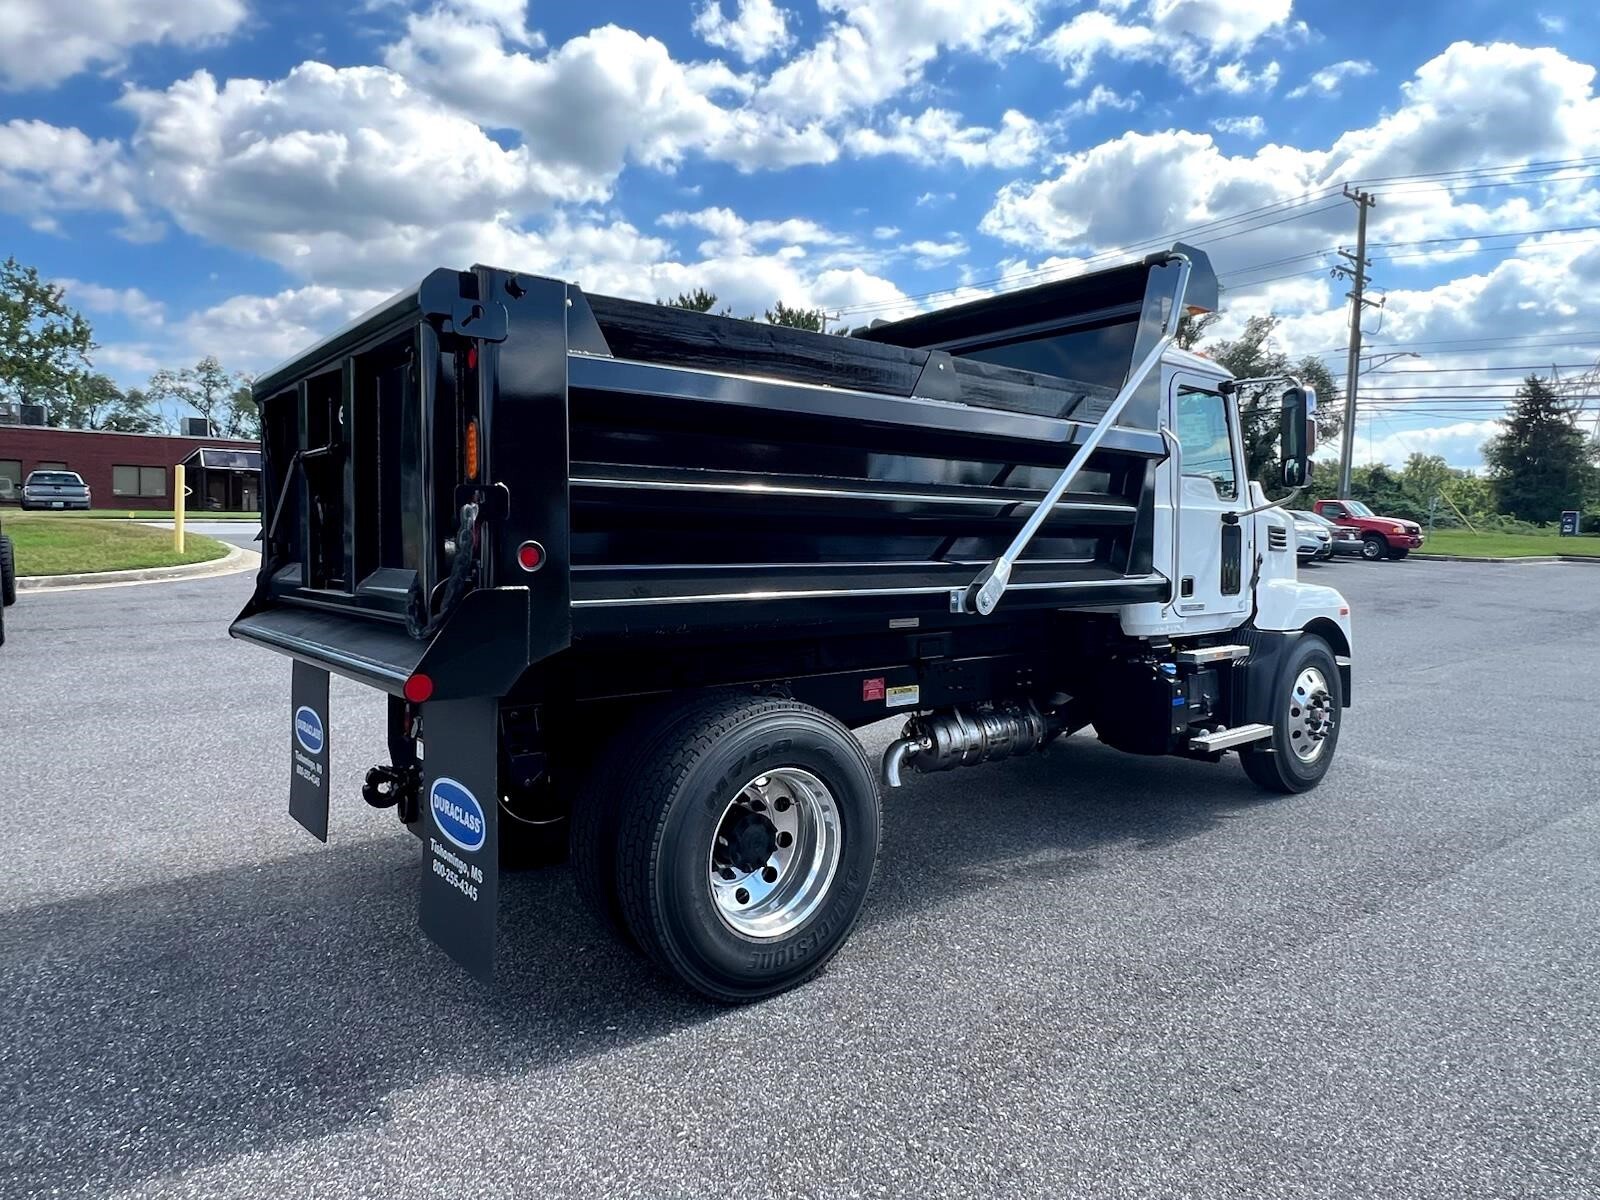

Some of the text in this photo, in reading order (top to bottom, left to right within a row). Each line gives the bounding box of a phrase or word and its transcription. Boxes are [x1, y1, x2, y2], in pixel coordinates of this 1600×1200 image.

[433, 793, 481, 834] DURACLASS
[430, 837, 483, 884] Tishomingo, MS
[432, 858, 478, 901] 800-255-4345
